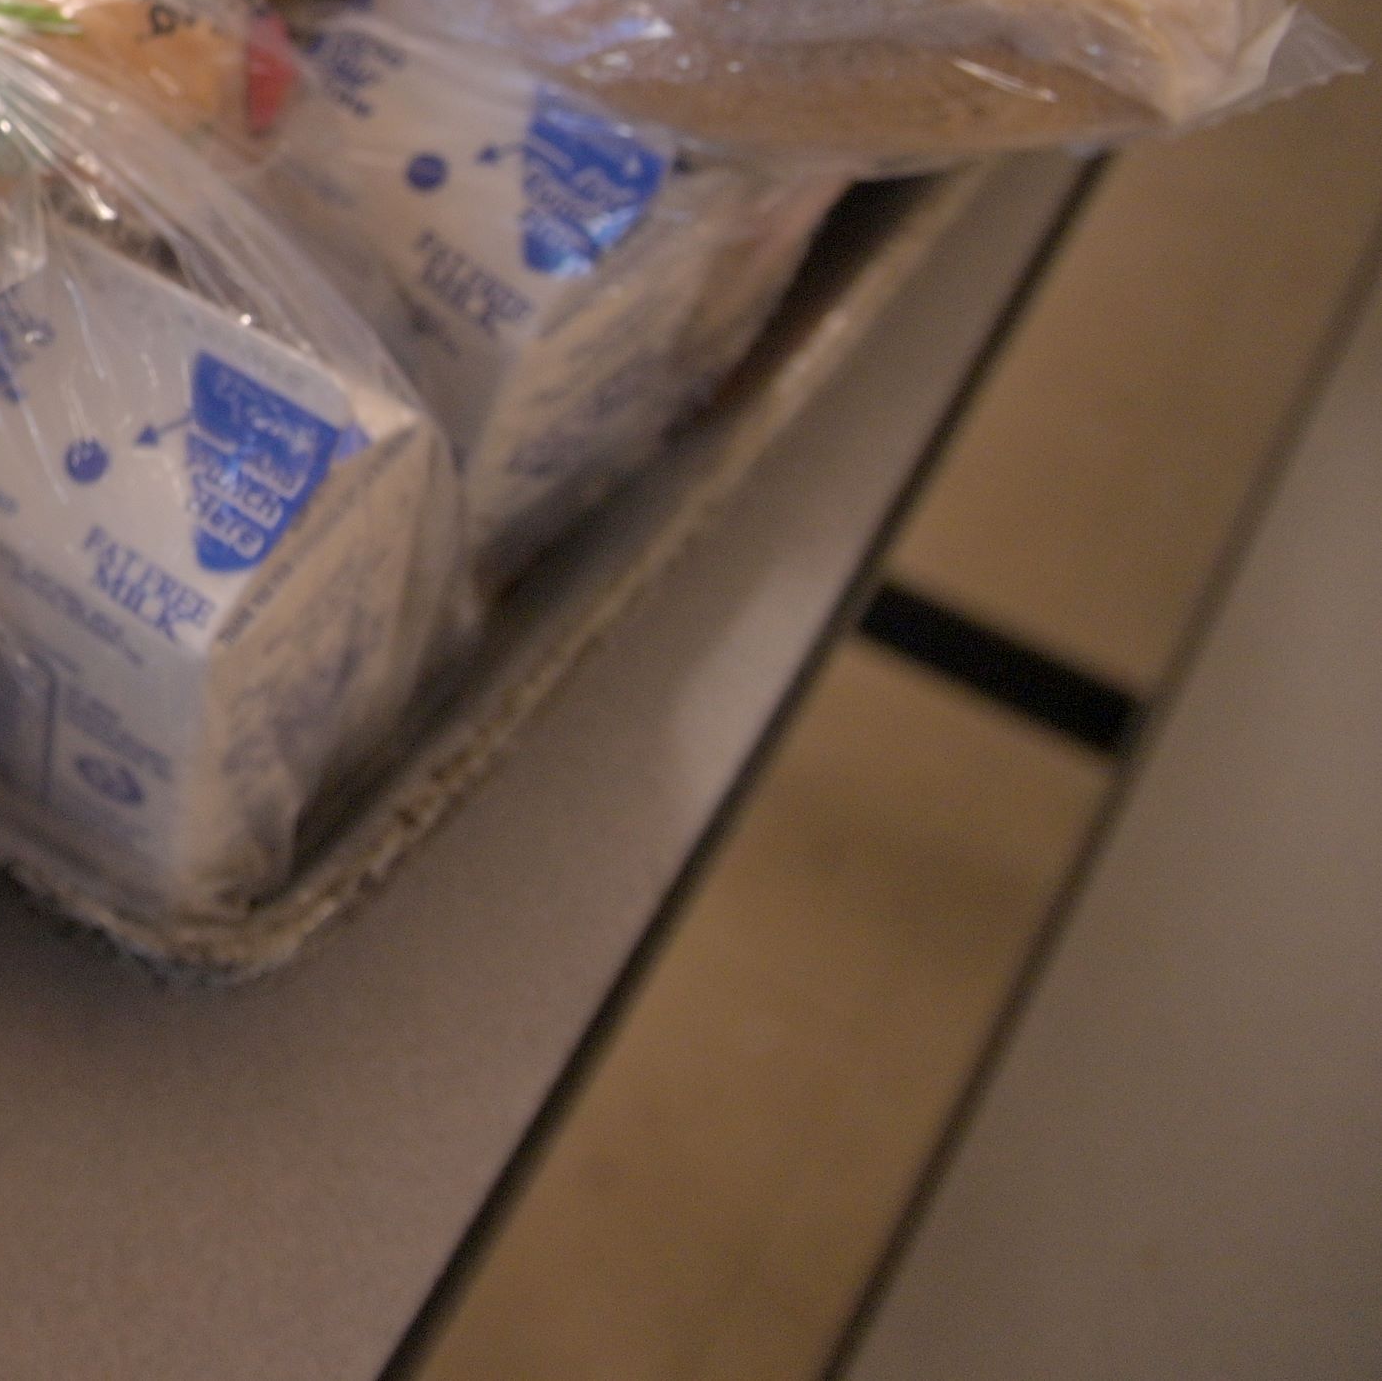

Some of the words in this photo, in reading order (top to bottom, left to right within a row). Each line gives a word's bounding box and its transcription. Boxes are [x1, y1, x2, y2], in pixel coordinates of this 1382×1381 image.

[80, 522, 144, 578] FAT
[135, 562, 216, 629] FREE
[87, 563, 186, 644] MILK
